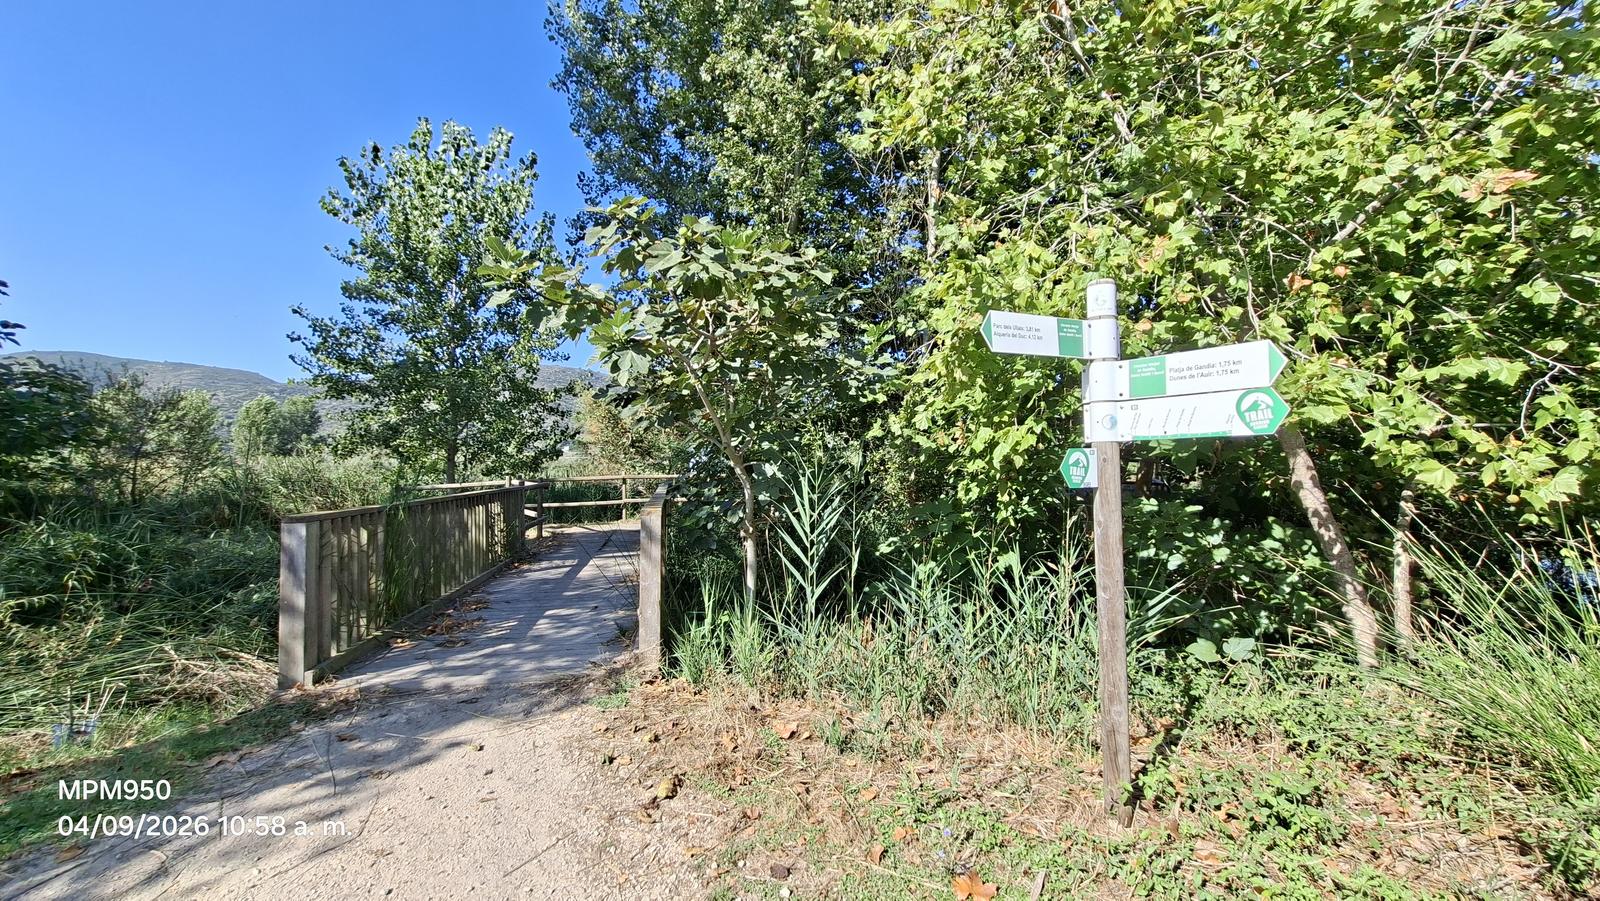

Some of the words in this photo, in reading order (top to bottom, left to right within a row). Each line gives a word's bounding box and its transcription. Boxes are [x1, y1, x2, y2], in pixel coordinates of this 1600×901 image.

[1169, 366, 1184, 374] Platja
[1219, 360, 1232, 368] 1,75
[1216, 368, 1228, 376] 1,75
[1244, 408, 1274, 422] TRAIL
[1070, 466, 1086, 477] TRAIL
